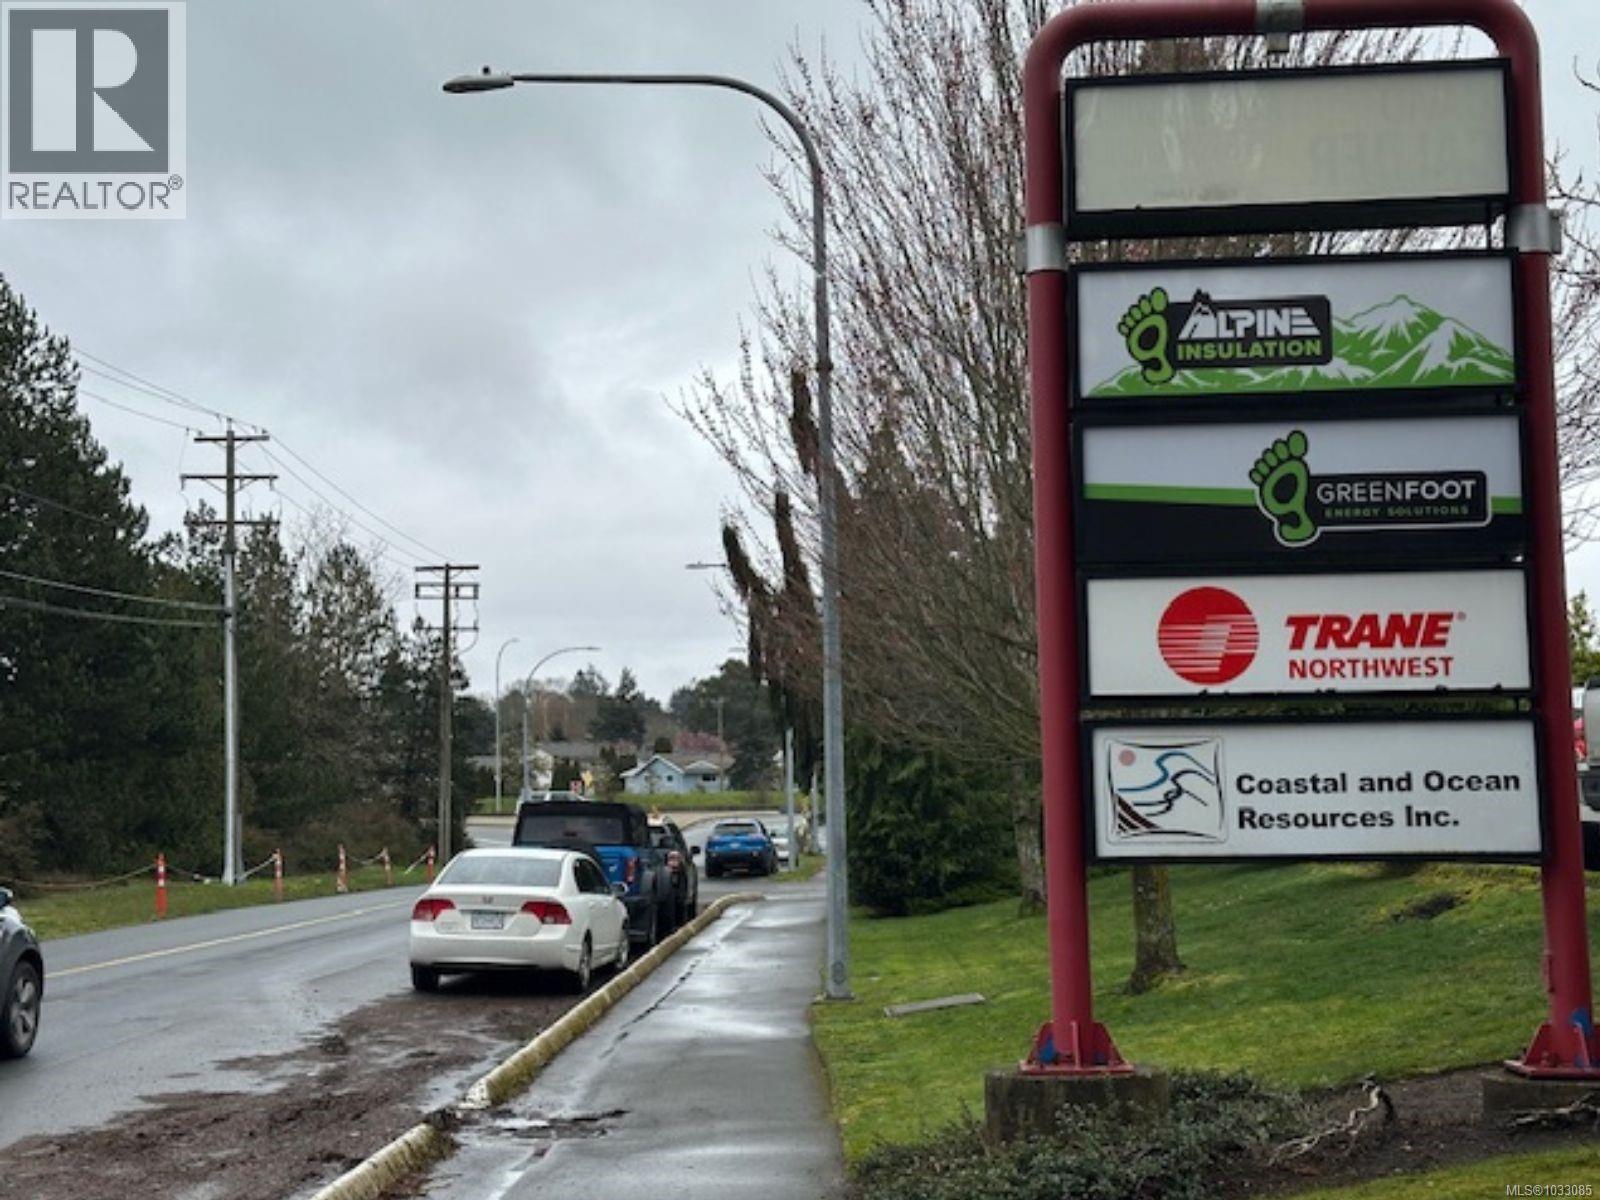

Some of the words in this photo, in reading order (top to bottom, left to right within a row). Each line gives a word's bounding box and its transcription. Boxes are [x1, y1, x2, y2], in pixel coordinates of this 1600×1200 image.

[1178, 302, 1321, 340] ALPINE
[1177, 339, 1322, 361] INSULATION
[1316, 480, 1477, 504] GREENFOOT
[1325, 507, 1380, 519] ENERGY
[1387, 505, 1469, 518] SOLUTIONS
[1288, 656, 1454, 679] NORTHWEST
[1236, 773, 1347, 796] Coastal
[1358, 772, 1414, 794] and
[1423, 770, 1521, 793] Ocean
[1238, 807, 1394, 831] Resources
[1405, 805, 1460, 829] Inc.
